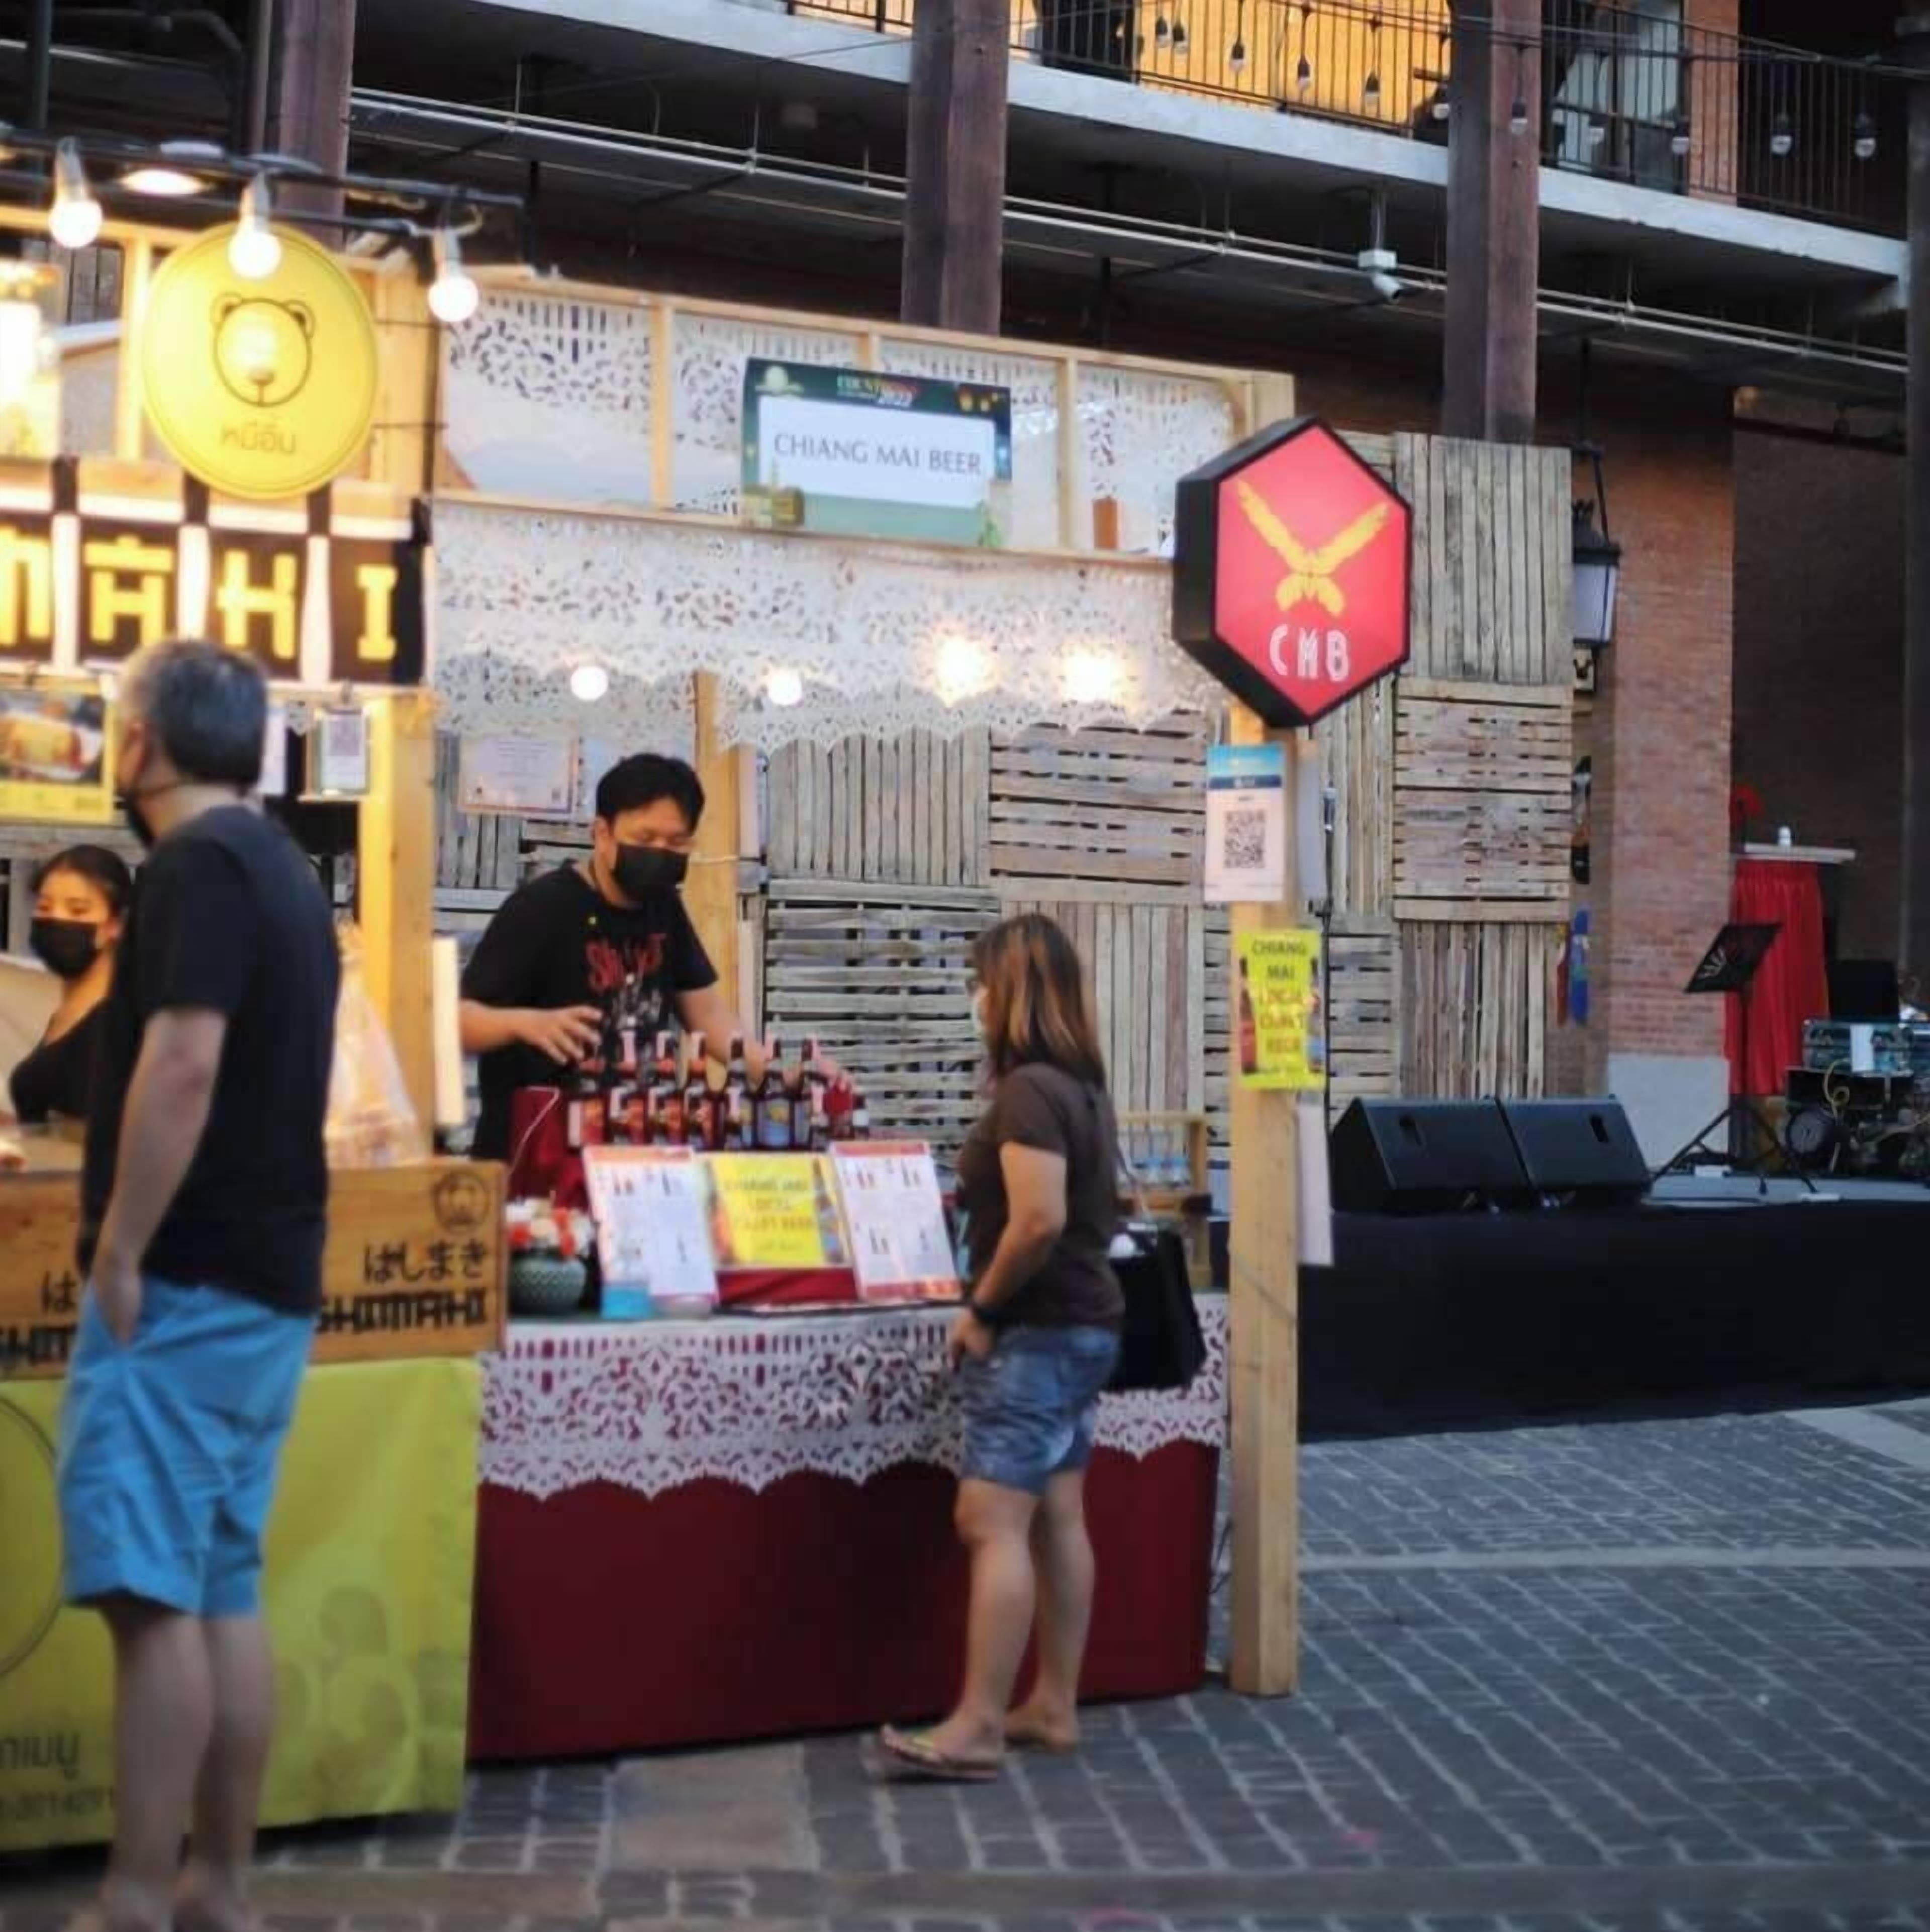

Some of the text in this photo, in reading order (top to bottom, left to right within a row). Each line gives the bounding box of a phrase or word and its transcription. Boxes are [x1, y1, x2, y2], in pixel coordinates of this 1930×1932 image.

[773, 433, 982, 475] CHIANG MAI BEER
[1251, 939, 1308, 956] CHIANG
[1267, 964, 1296, 980] MAI
[363, 1238, 489, 1284] はしまき
